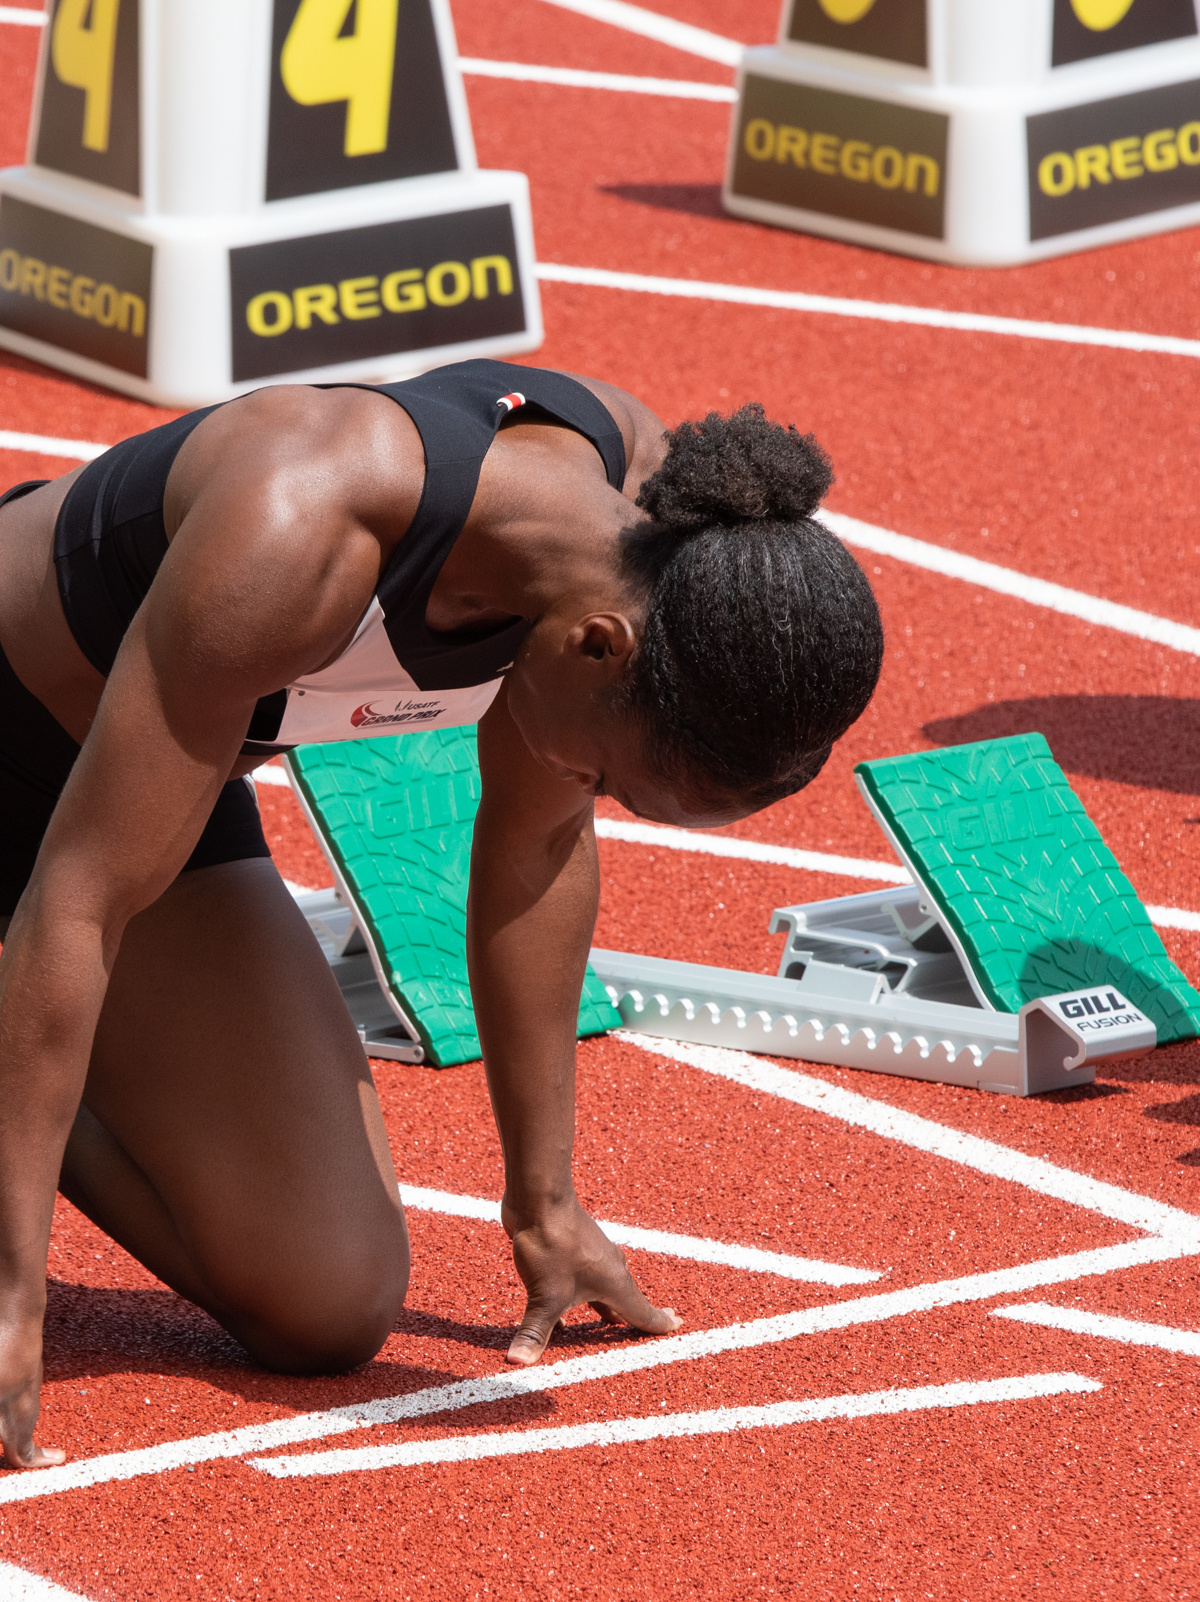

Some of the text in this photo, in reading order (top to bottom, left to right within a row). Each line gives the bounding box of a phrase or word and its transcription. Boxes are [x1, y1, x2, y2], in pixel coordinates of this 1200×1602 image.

[281, 0, 398, 158] 4
[745, 118, 940, 197] OREGON
[246, 254, 513, 338] OREGON
[360, 708, 447, 727] GRAND PRIX
[946, 798, 1057, 852] GILL
[1059, 992, 1126, 1019] GILL
[1077, 1012, 1142, 1032] FUSION
